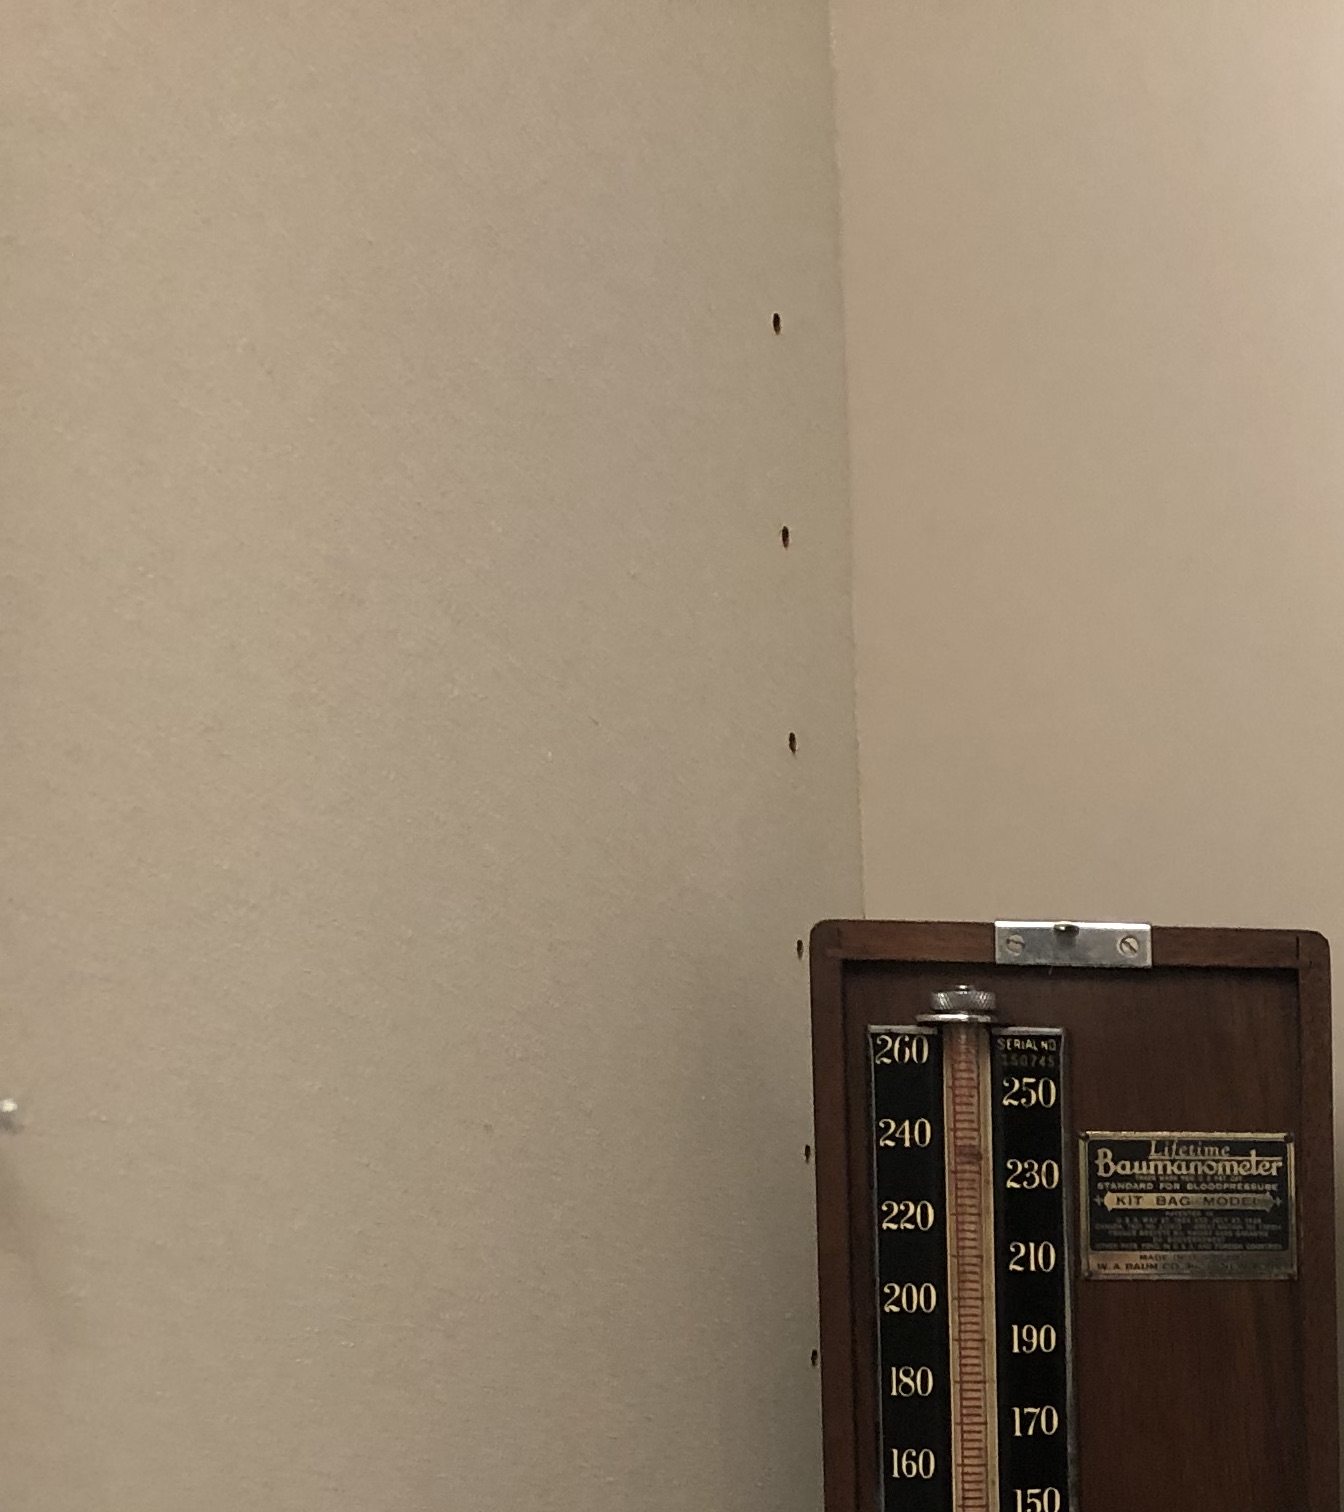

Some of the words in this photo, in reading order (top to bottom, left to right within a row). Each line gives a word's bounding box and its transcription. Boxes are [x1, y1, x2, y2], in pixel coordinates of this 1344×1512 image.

[876, 1035, 928, 1064] 260
[1003, 1078, 1056, 1106] 250
[879, 1118, 930, 1147] 240
[1094, 1148, 1283, 1178] Baumanometer
[1148, 1140, 1231, 1159] Lifetime
[1007, 1159, 1059, 1189] 230
[882, 1201, 934, 1230] 220
[1116, 1196, 1143, 1205] KIT
[1156, 1197, 1191, 1206] BAG
[1009, 1242, 1055, 1271] 210
[884, 1283, 936, 1312] 200
[1012, 1325, 1056, 1352] 190
[891, 1367, 933, 1396] 180
[1013, 1406, 1058, 1436] 170
[892, 1449, 934, 1478] 160
